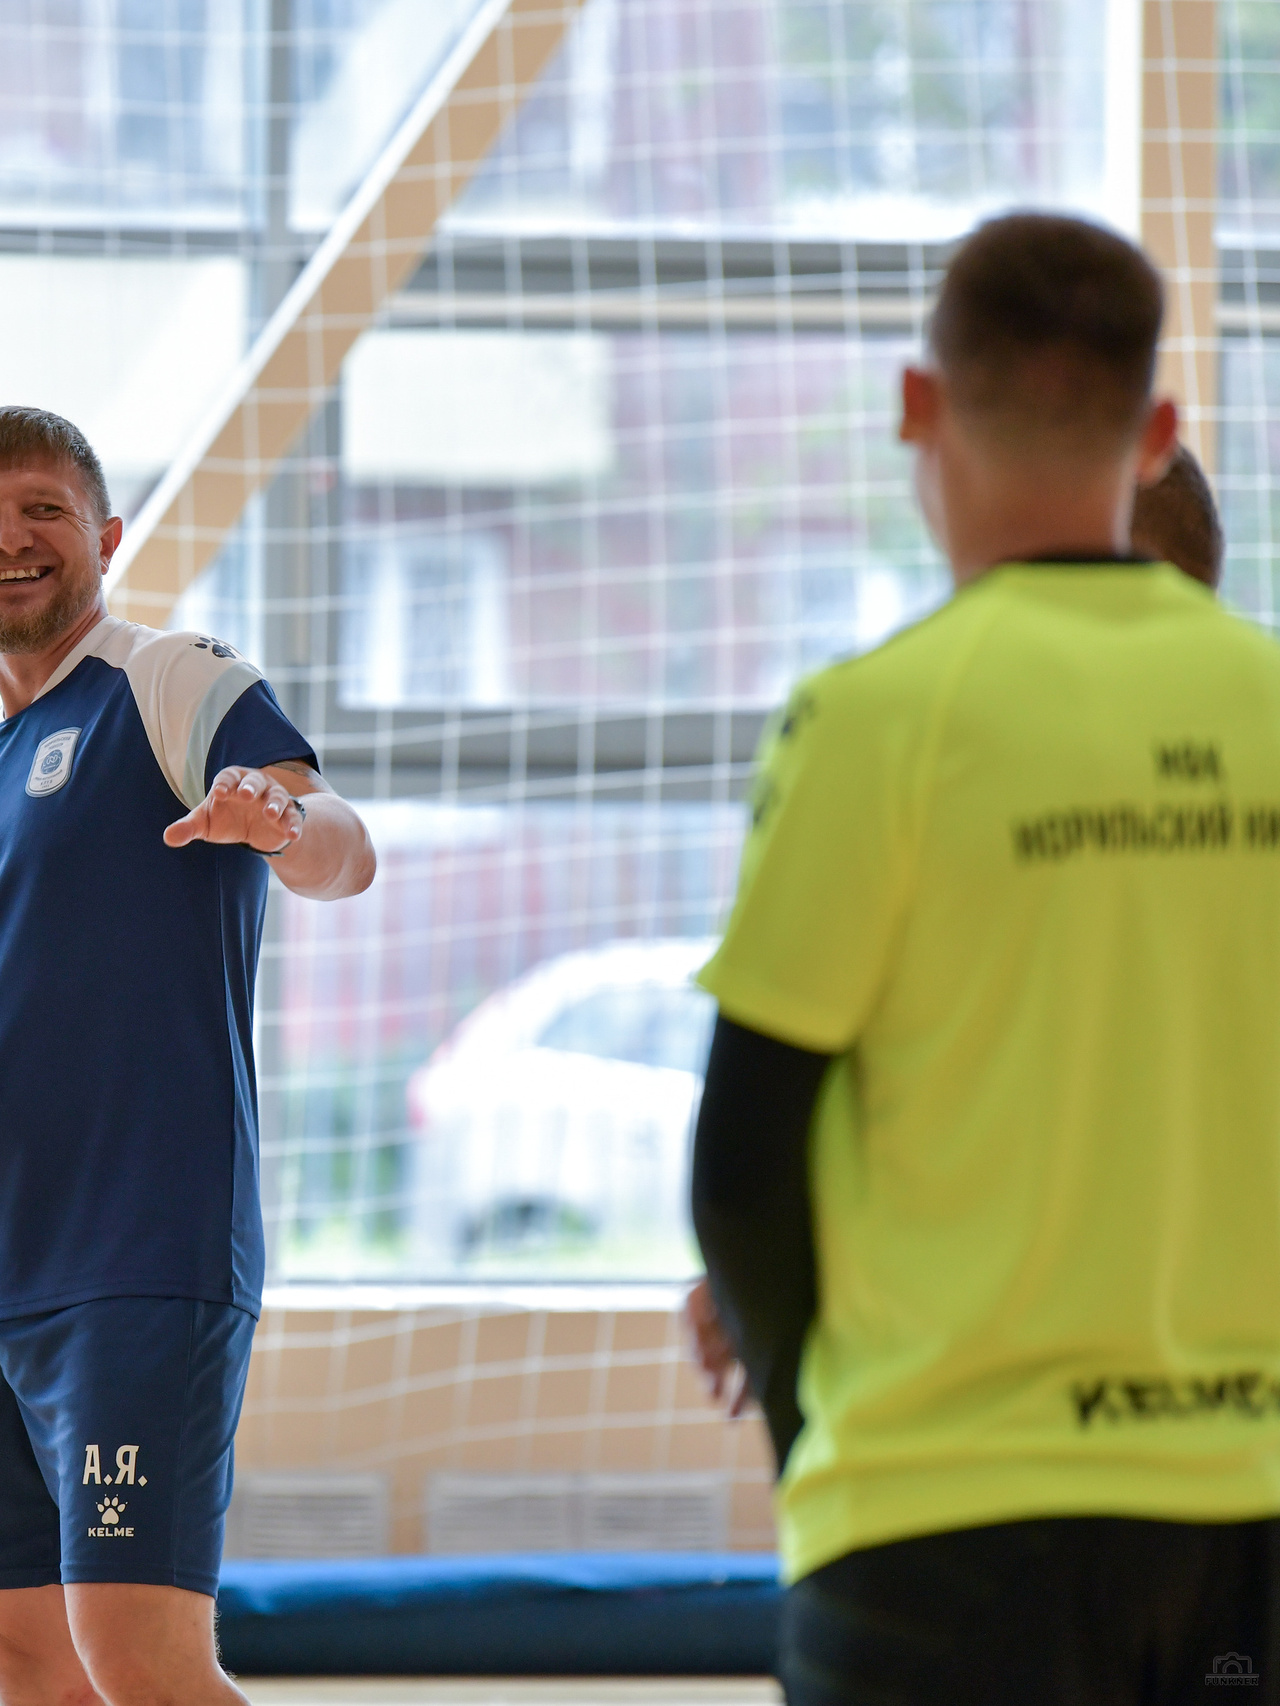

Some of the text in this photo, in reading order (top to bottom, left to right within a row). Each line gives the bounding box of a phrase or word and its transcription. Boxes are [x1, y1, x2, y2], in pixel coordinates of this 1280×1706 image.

[1072, 1372, 1265, 1429] KELME
[82, 1444, 148, 1487] А.Я.
[87, 1527, 135, 1537] KELME
